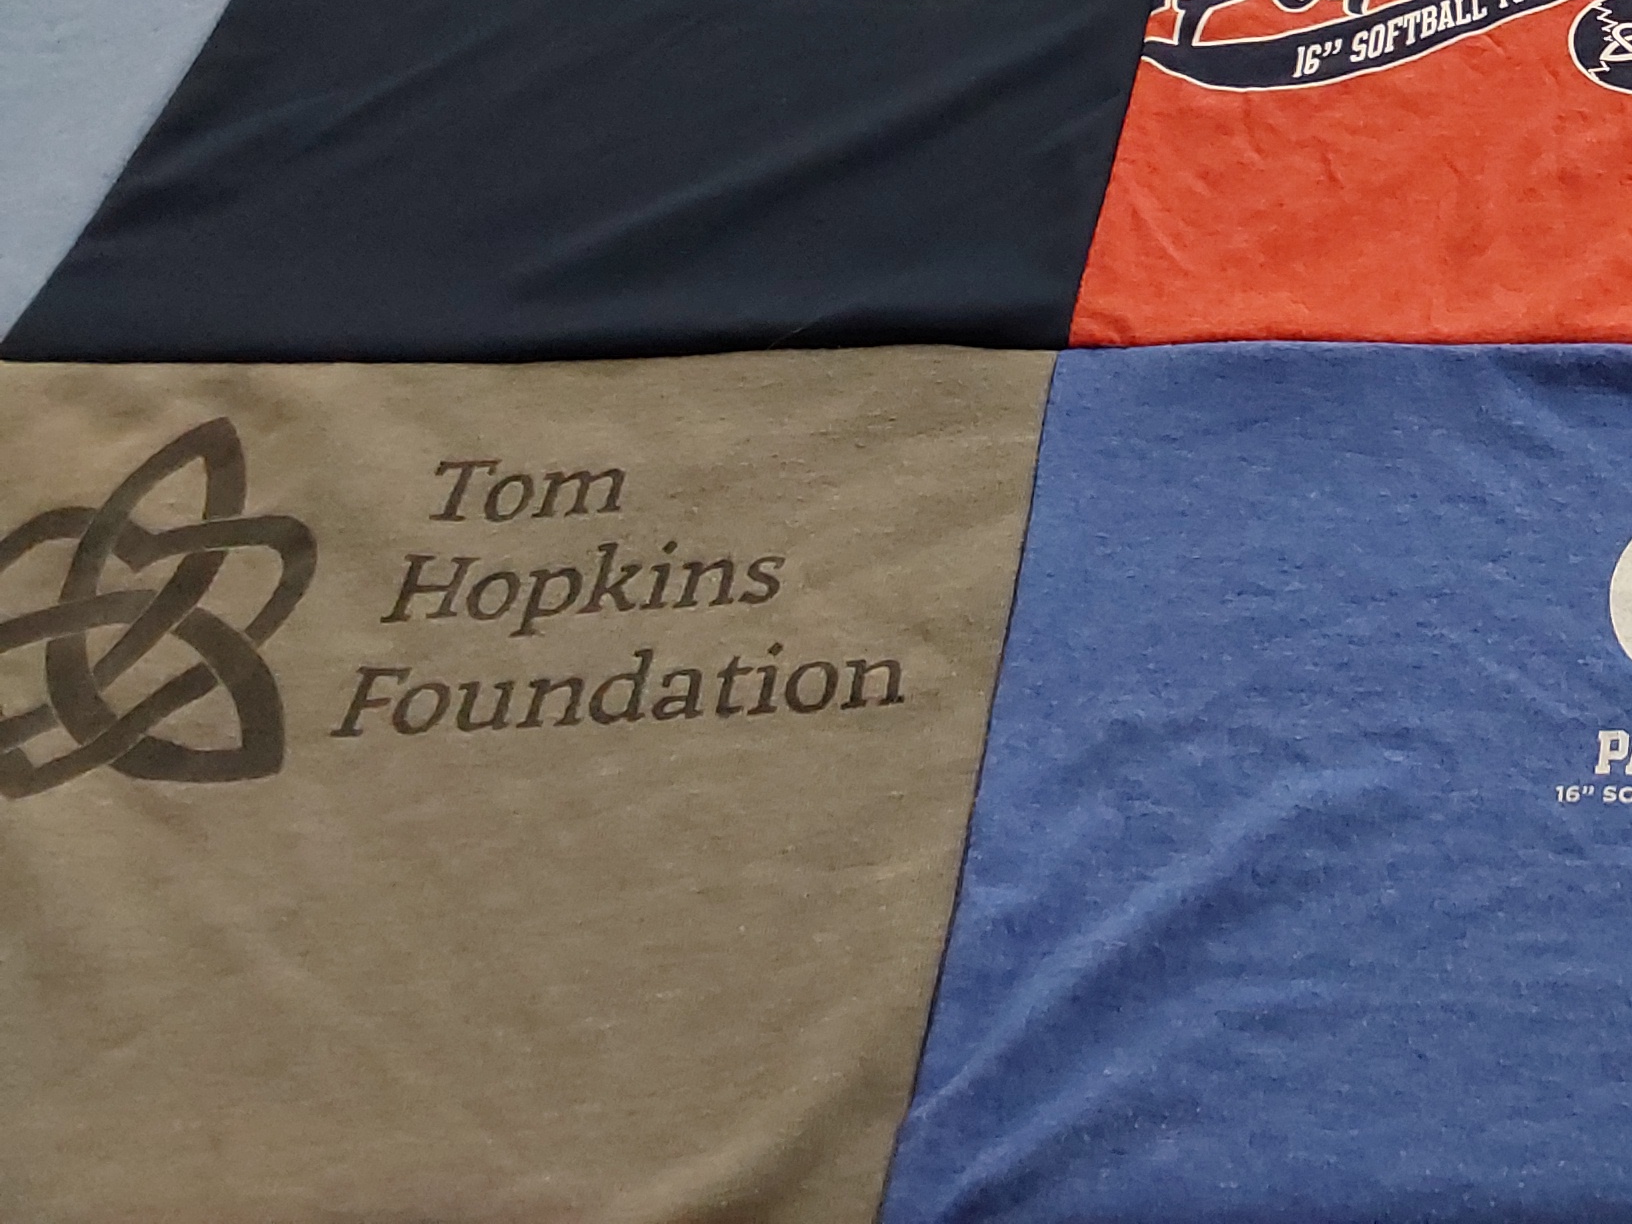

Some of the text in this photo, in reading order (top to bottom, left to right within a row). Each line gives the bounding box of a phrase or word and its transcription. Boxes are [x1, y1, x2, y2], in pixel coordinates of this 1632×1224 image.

[429, 459, 627, 523] Tom
[380, 540, 787, 638] Hopkins
[330, 642, 906, 738] Foundation
